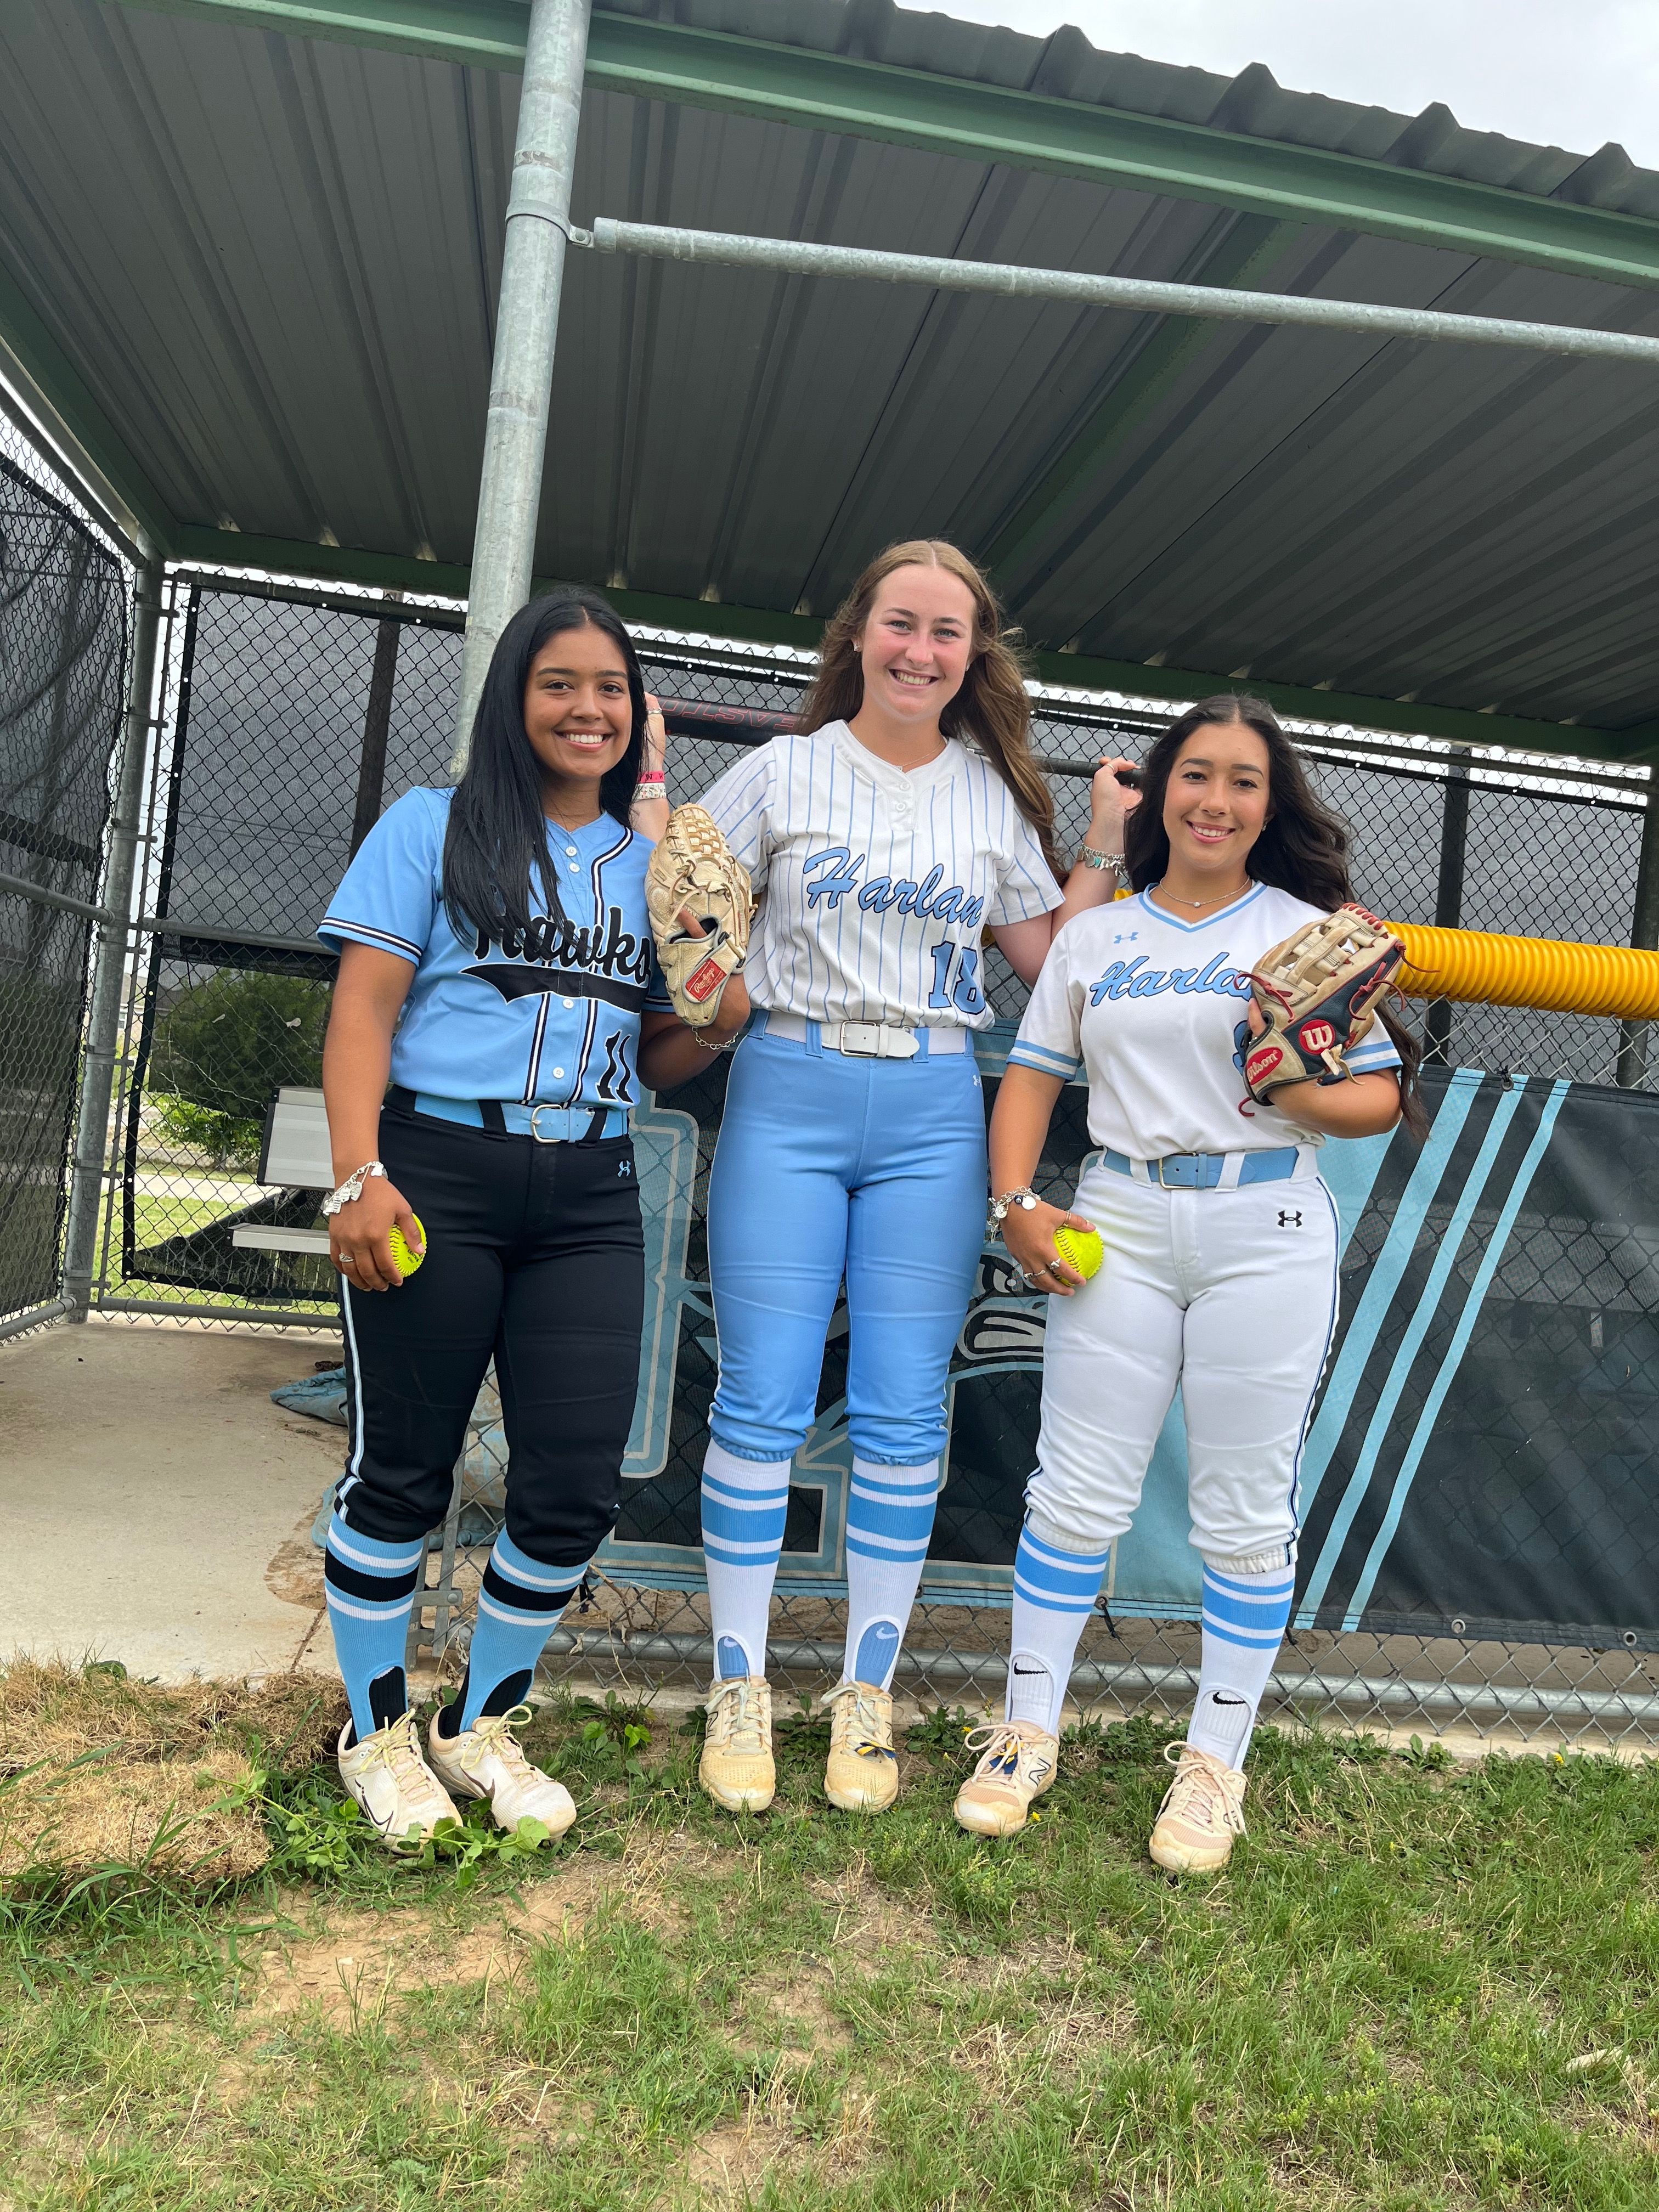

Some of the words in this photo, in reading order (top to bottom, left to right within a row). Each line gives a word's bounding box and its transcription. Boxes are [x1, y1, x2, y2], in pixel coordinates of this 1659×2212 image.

[657, 696, 797, 733] EASTO
[803, 847, 984, 928] Harlan
[694, 968, 715, 994] Rawlings
[928, 940, 986, 1015] 18
[1090, 952, 1253, 1007] Harla
[596, 1029, 634, 1106] 11
